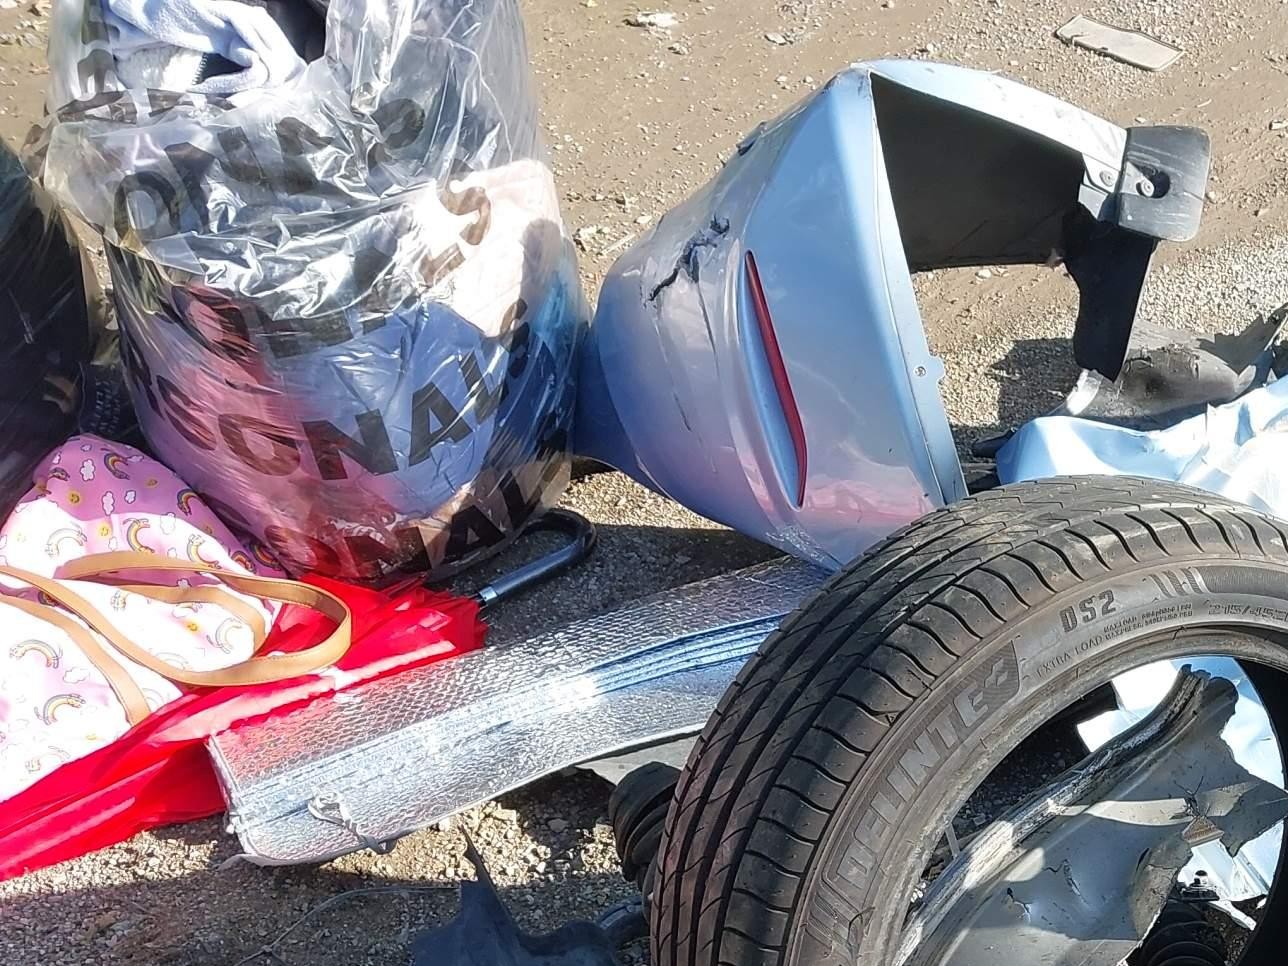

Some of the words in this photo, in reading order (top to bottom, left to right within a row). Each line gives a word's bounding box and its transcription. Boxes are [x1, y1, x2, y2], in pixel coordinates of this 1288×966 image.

[1059, 589, 1117, 633] DS2
[1036, 652, 1072, 679] EXTRA
[1074, 634, 1104, 656] LOAD
[835, 680, 990, 890] DELINTE
